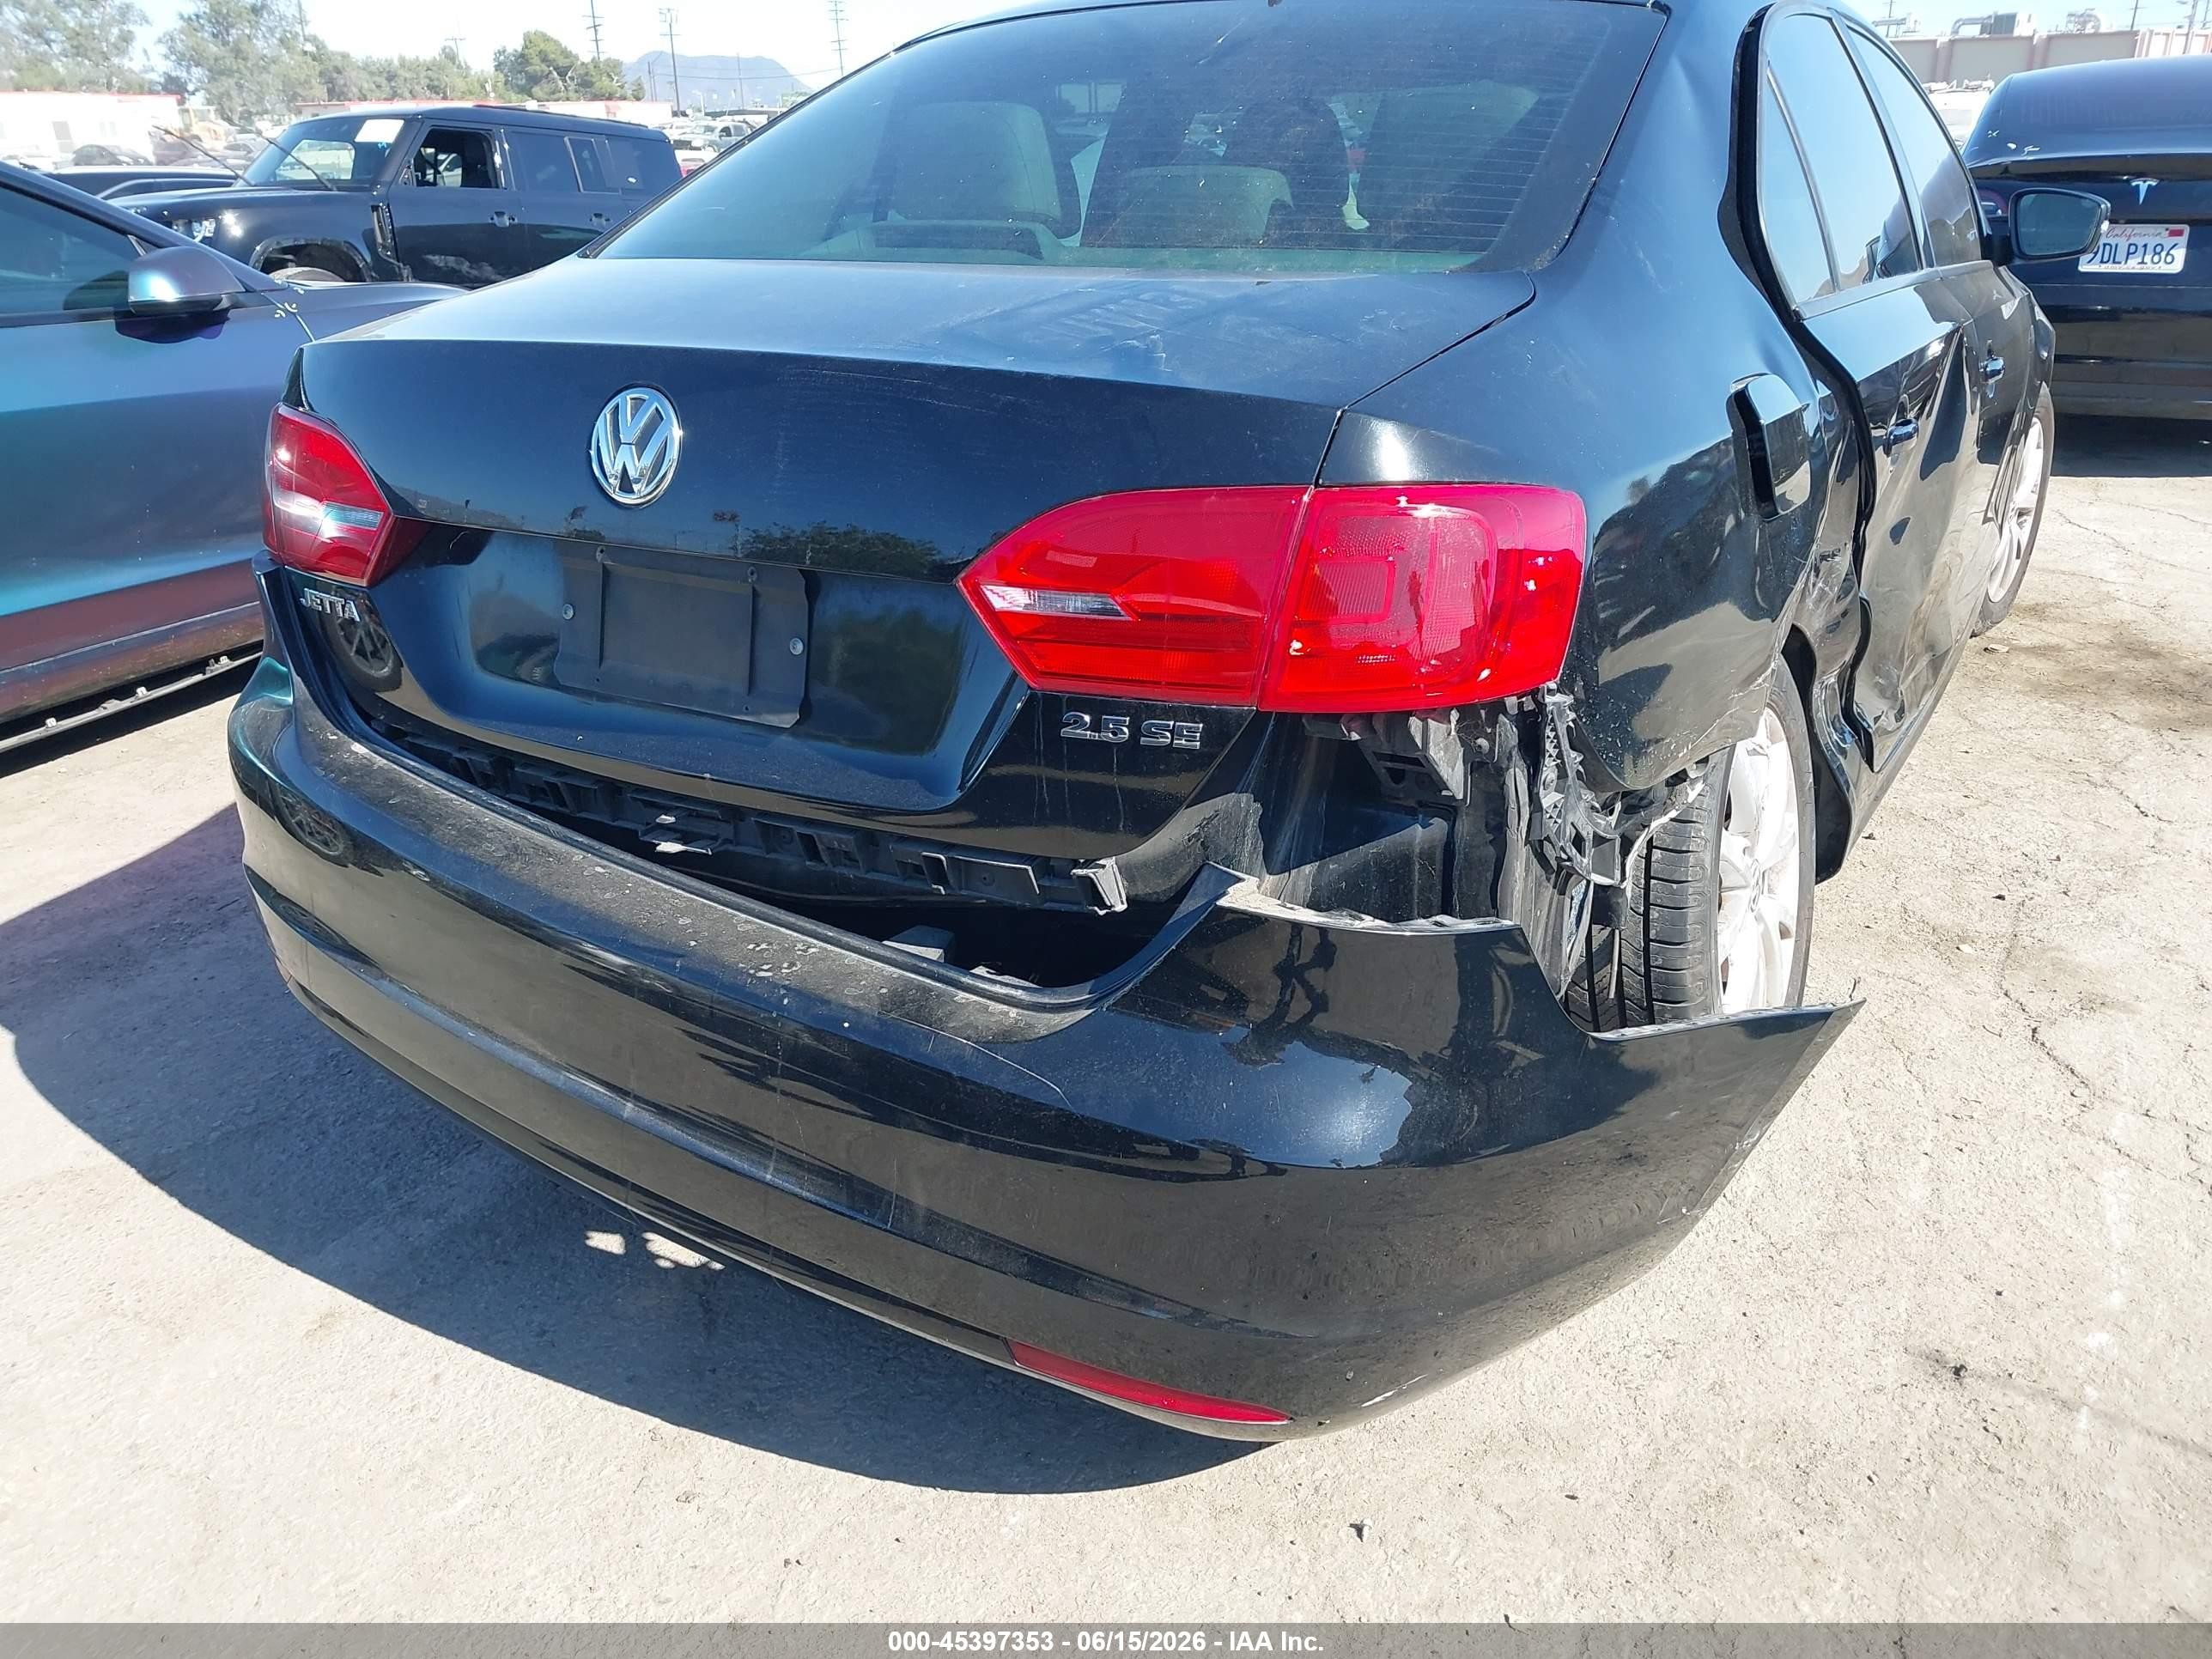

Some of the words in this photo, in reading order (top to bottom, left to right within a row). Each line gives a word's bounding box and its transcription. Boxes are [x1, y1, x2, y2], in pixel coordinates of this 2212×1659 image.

[2106, 227, 2165, 241] California
[300, 587, 361, 622] JETTA
[1060, 712, 1130, 743] 2.5
[1140, 720, 1203, 749] SE
